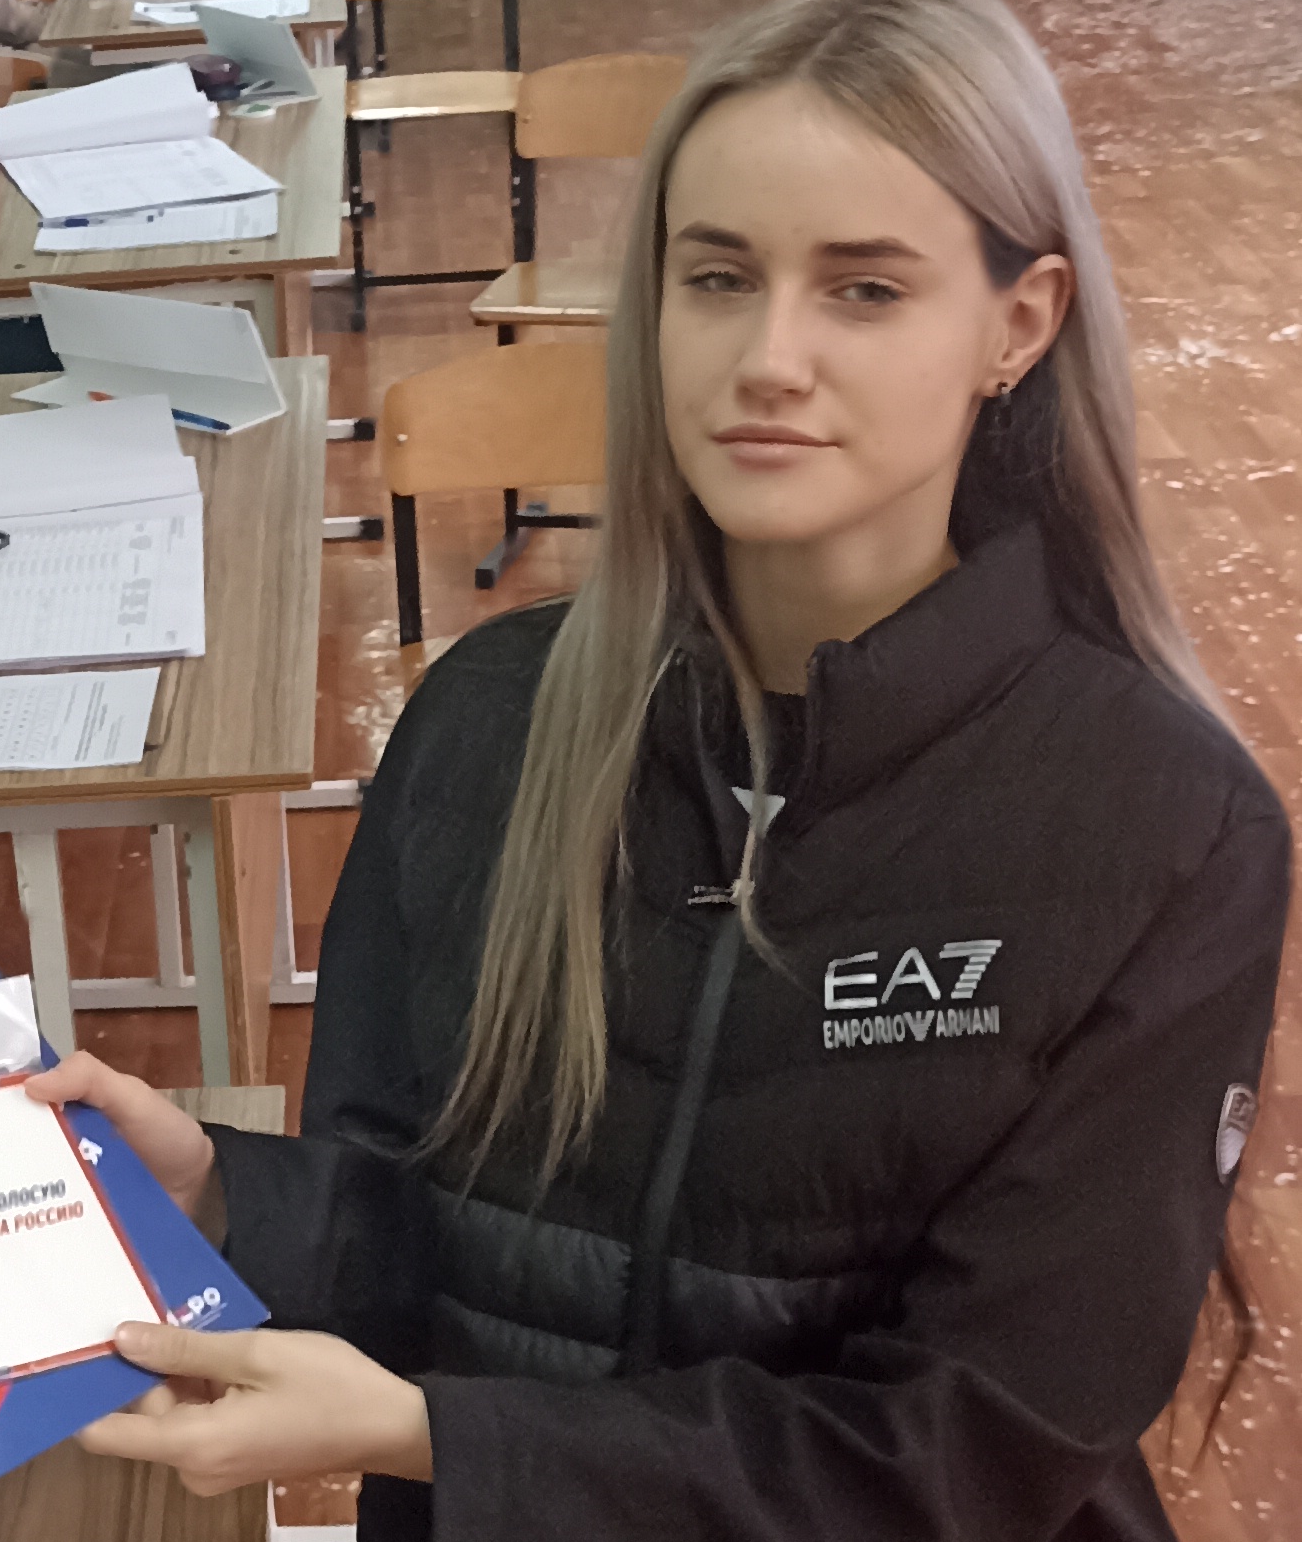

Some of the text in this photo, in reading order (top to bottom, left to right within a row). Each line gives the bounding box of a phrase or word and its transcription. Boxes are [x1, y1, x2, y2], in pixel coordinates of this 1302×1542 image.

[824, 939, 1003, 1011] EA7
[822, 1004, 1001, 1050] EMPORIO ARMANI
[13, 1200, 84, 1234] РОССИЮ
